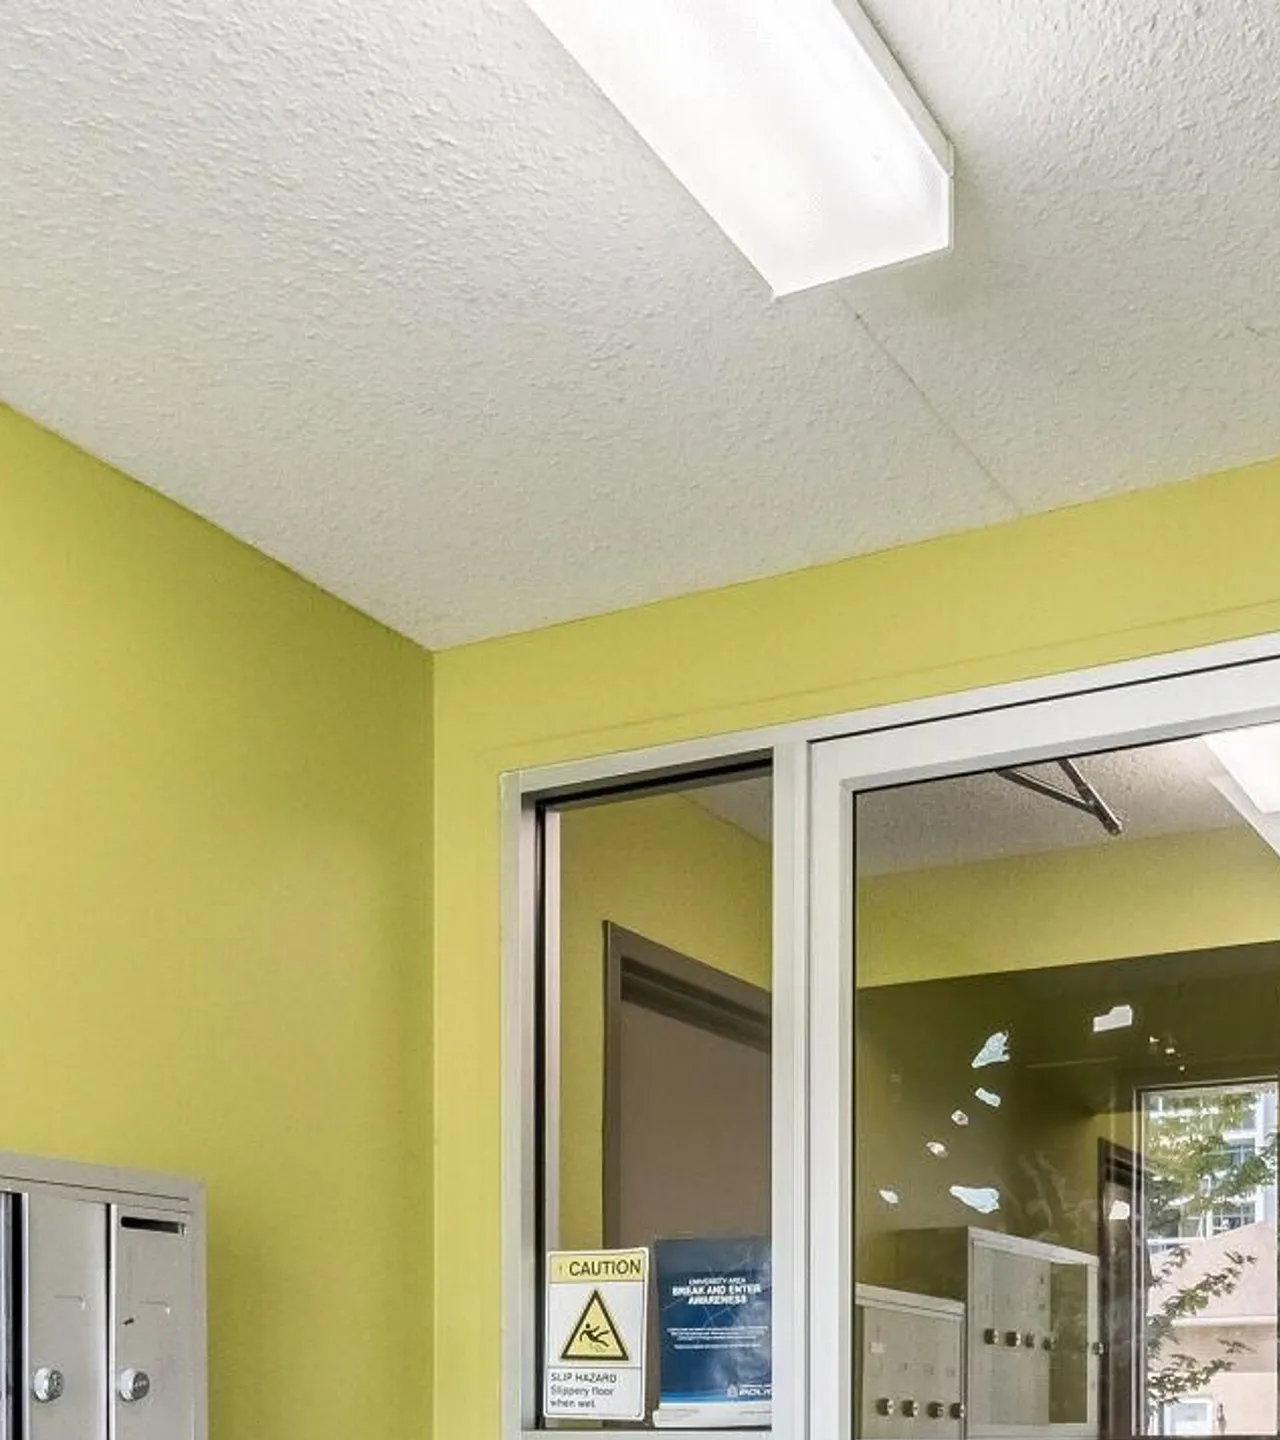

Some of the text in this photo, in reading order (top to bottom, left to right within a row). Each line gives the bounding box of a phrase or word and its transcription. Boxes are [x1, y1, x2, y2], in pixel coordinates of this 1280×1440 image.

[568, 1260, 641, 1276] CAUTION
[672, 1283, 762, 1296] BREAK AND ENTER
[688, 1295, 747, 1305] AWARENESS
[551, 1373, 617, 1383] SLIP HAZARD
[550, 1385, 616, 1396] Slippery floor
[550, 1398, 576, 1408] when
